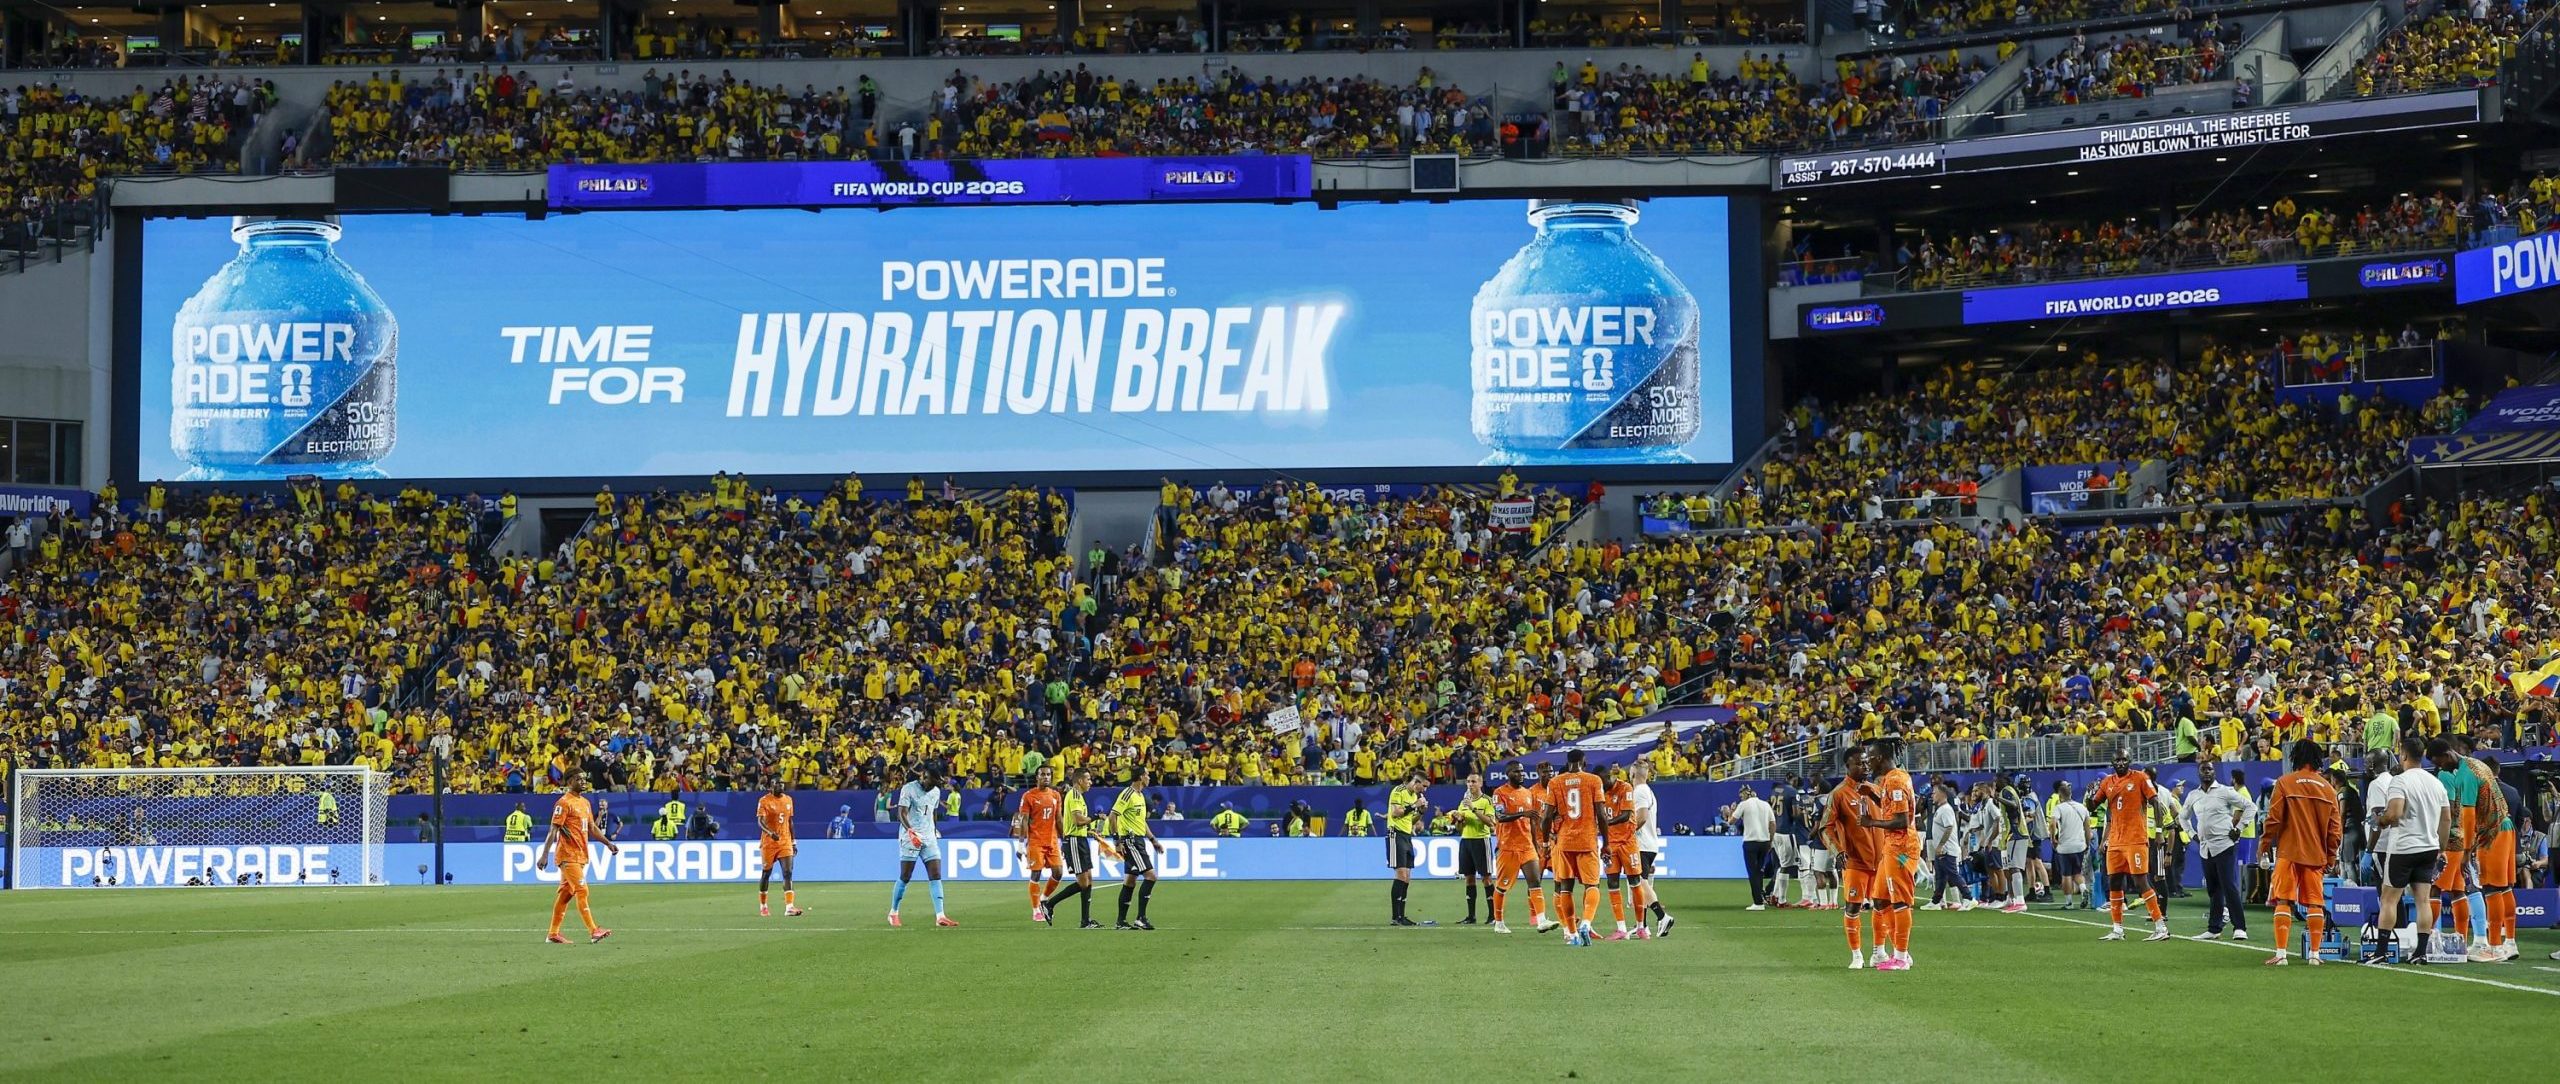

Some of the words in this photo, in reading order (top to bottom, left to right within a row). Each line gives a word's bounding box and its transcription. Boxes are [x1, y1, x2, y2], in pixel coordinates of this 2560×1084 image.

[2100, 122, 2198, 143] PHILADELPHIA,
[2202, 118, 2227, 132] THE
[2231, 112, 2290, 130] REFEREE
[2080, 145, 2106, 160] HAS
[2109, 142, 2140, 157] NOW
[2143, 138, 2189, 154] BLOWN
[2193, 134, 2218, 148] THE
[2221, 127, 2280, 146] WHISTLE
[2284, 124, 2311, 139] FOR
[1793, 160, 1817, 172] TEXT
[1830, 151, 1935, 176] 267-570-4444
[1787, 171, 1822, 184] ASSIST
[833, 183, 868, 196] FIFA
[870, 182, 929, 196] WORLD
[932, 182, 964, 195] CUP
[966, 181, 1024, 195] 2026
[882, 258, 1166, 300] POWERADE
[2045, 300, 2077, 315] FIFA
[2079, 296, 2132, 312] WORLD
[2134, 293, 2164, 308] CUP
[2166, 288, 2220, 305] 2026
[1486, 306, 1656, 348] POWER
[186, 322, 355, 363] POWER
[501, 325, 653, 363] TIME
[726, 308, 1106, 417] HYDRATION
[1110, 305, 1342, 413] BREAK
[548, 366, 686, 405] FOR
[1534, 393, 1572, 403] BERRY
[232, 408, 270, 419] BERRY
[1651, 407, 1689, 425] MORE
[348, 423, 385, 439] MORE
[2077, 470, 2093, 480] FIF
[1375, 485, 1390, 493] 109
[2060, 481, 2084, 491] WOR
[1321, 489, 1364, 501] 026
[2071, 492, 2089, 501] 20
[366, 735, 376, 744] 10
[1567, 788, 1581, 820] 9
[1770, 795, 1784, 817] 25
[2116, 797, 2123, 811] 6
[778, 812, 785, 824] 5
[1043, 807, 1053, 820] 17
[1604, 807, 1613, 820] 19
[62, 845, 331, 886] POWERADE
[948, 839, 1219, 878] PORDE
[1629, 852, 1639, 866] 19
[2134, 852, 2141, 866] 6
[2515, 906, 2545, 916] 026
